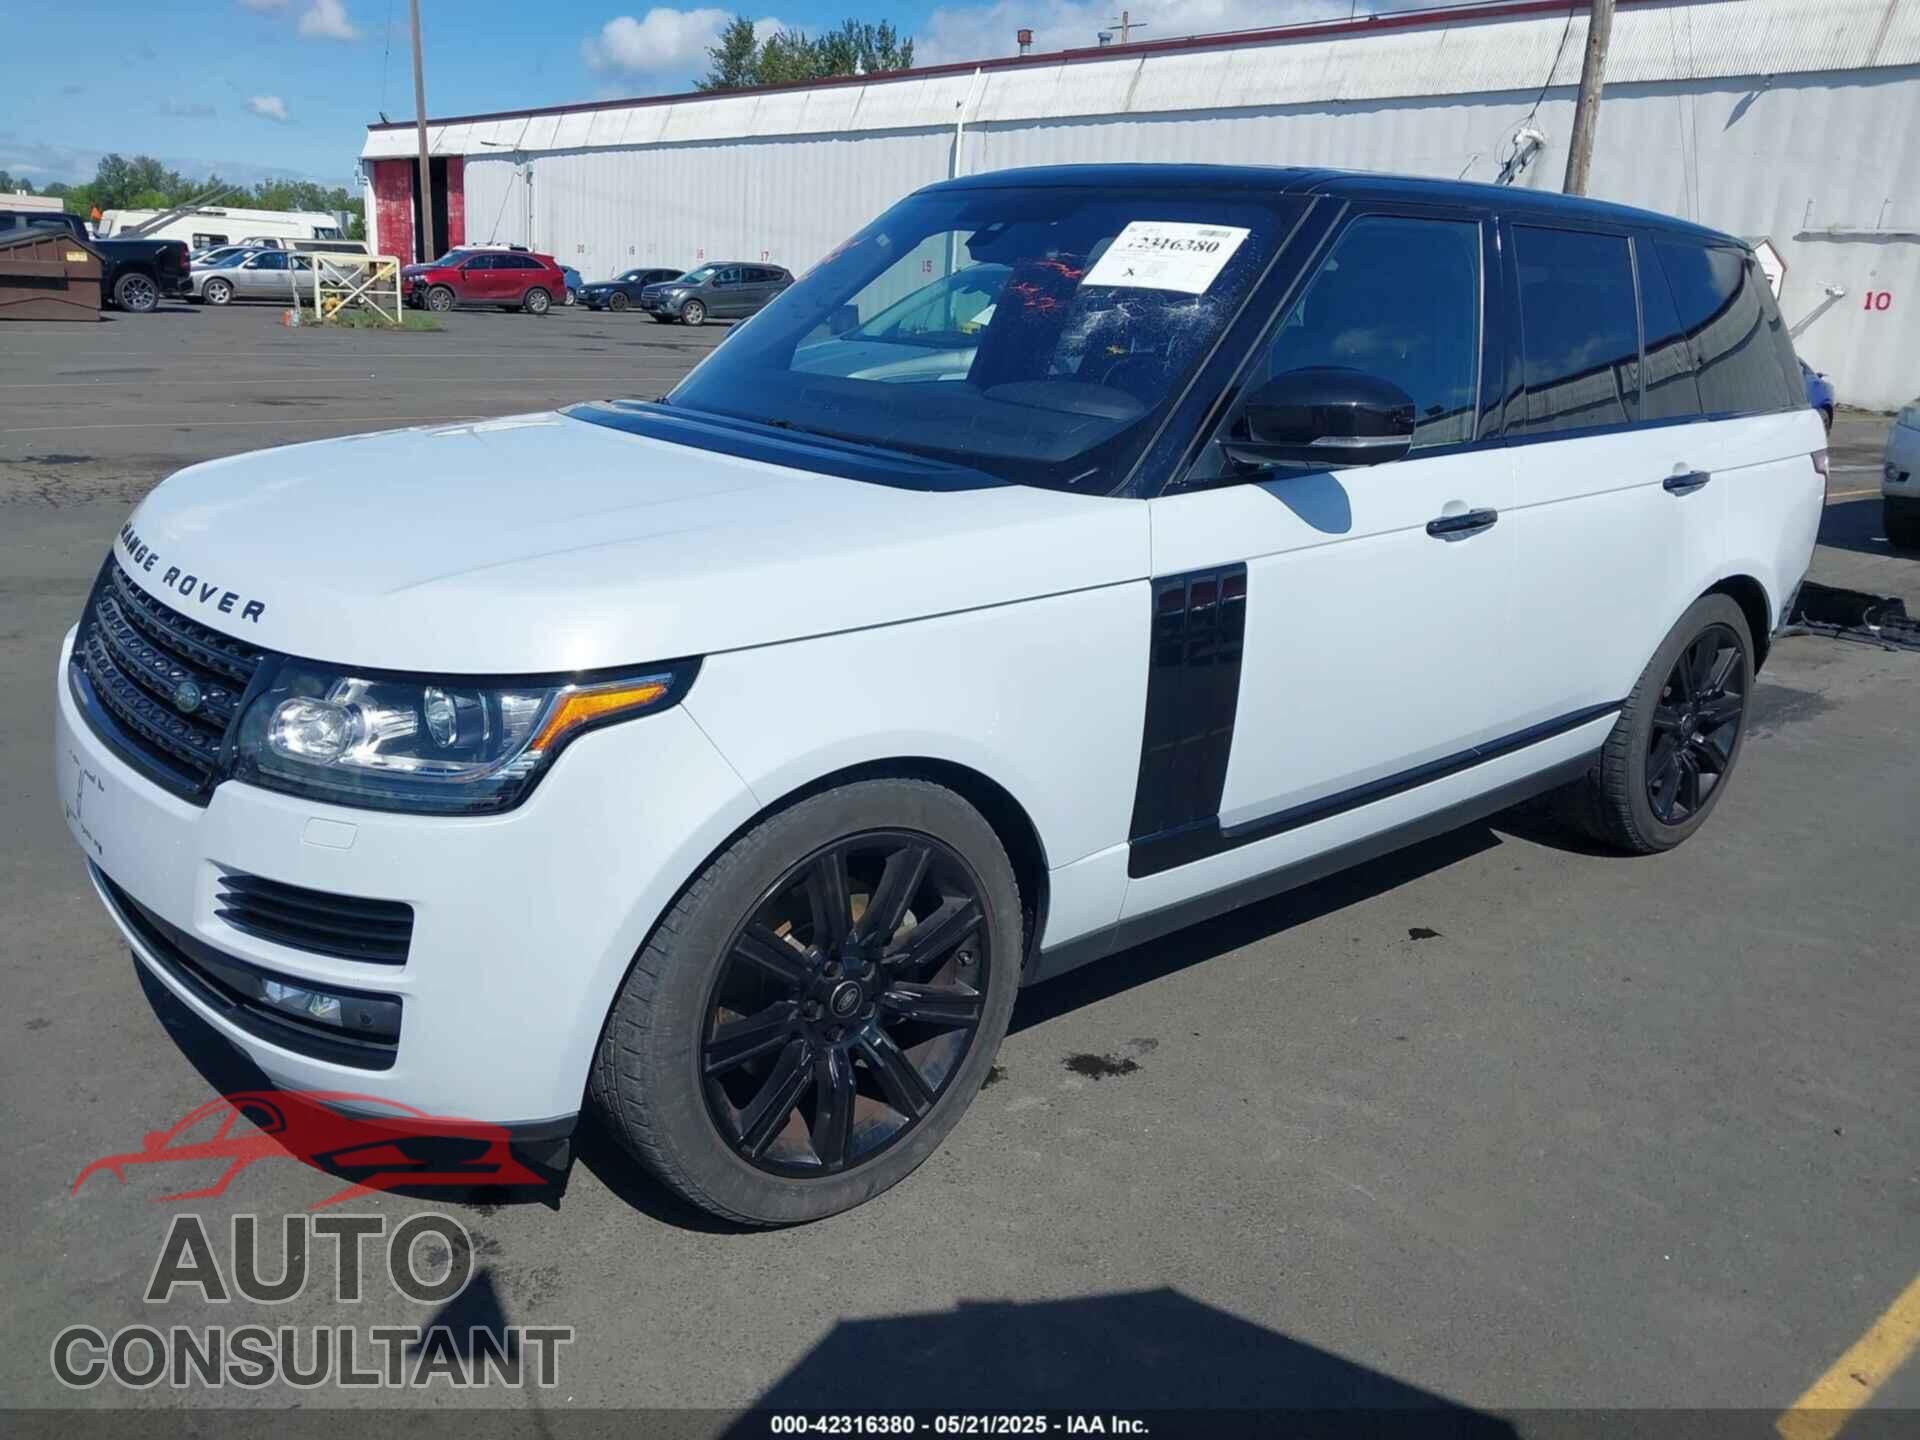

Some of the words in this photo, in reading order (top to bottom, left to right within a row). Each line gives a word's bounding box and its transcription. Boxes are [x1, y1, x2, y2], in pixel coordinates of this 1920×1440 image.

[1128, 236, 1220, 254] 2316380
[921, 260, 933, 273] 15
[1863, 292, 1892, 310] 10
[120, 521, 160, 572] RANGE
[162, 566, 266, 623] ROVER
